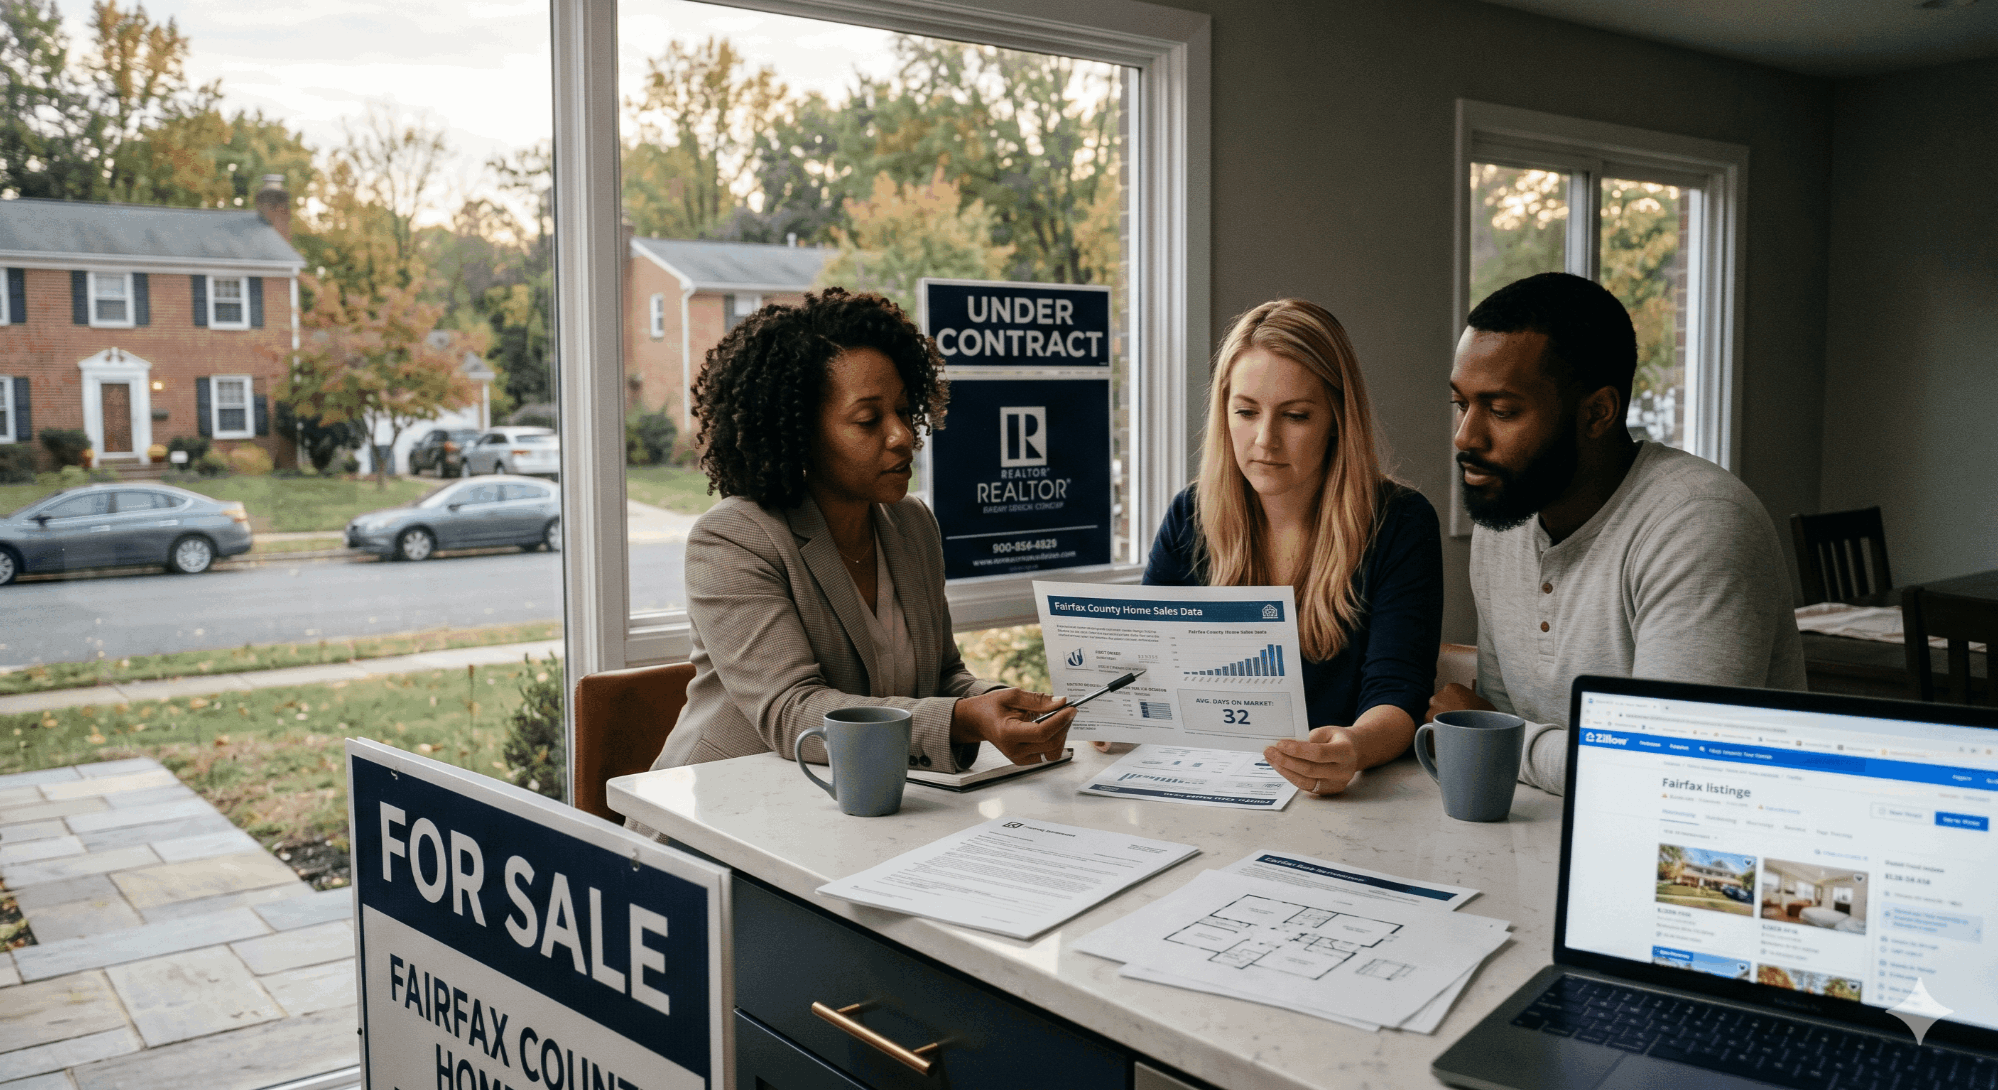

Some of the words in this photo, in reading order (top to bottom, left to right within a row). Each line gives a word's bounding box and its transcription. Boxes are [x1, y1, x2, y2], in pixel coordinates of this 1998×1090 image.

[967, 295, 1073, 325] UNDER
[936, 328, 1103, 357] CONTRACT
[1054, 602, 1086, 612] Fairfax
[1087, 604, 1121, 615] County
[1123, 606, 1151, 615] Home
[1153, 606, 1178, 616] Sales
[1180, 608, 1203, 616] Data
[1222, 708, 1251, 725] 32
[1662, 777, 1703, 792] Fairfax
[380, 800, 487, 928] FOR
[504, 855, 671, 1017] SALE
[390, 953, 511, 1068] FAIRFAX
[436, 1043, 517, 1090] HO
